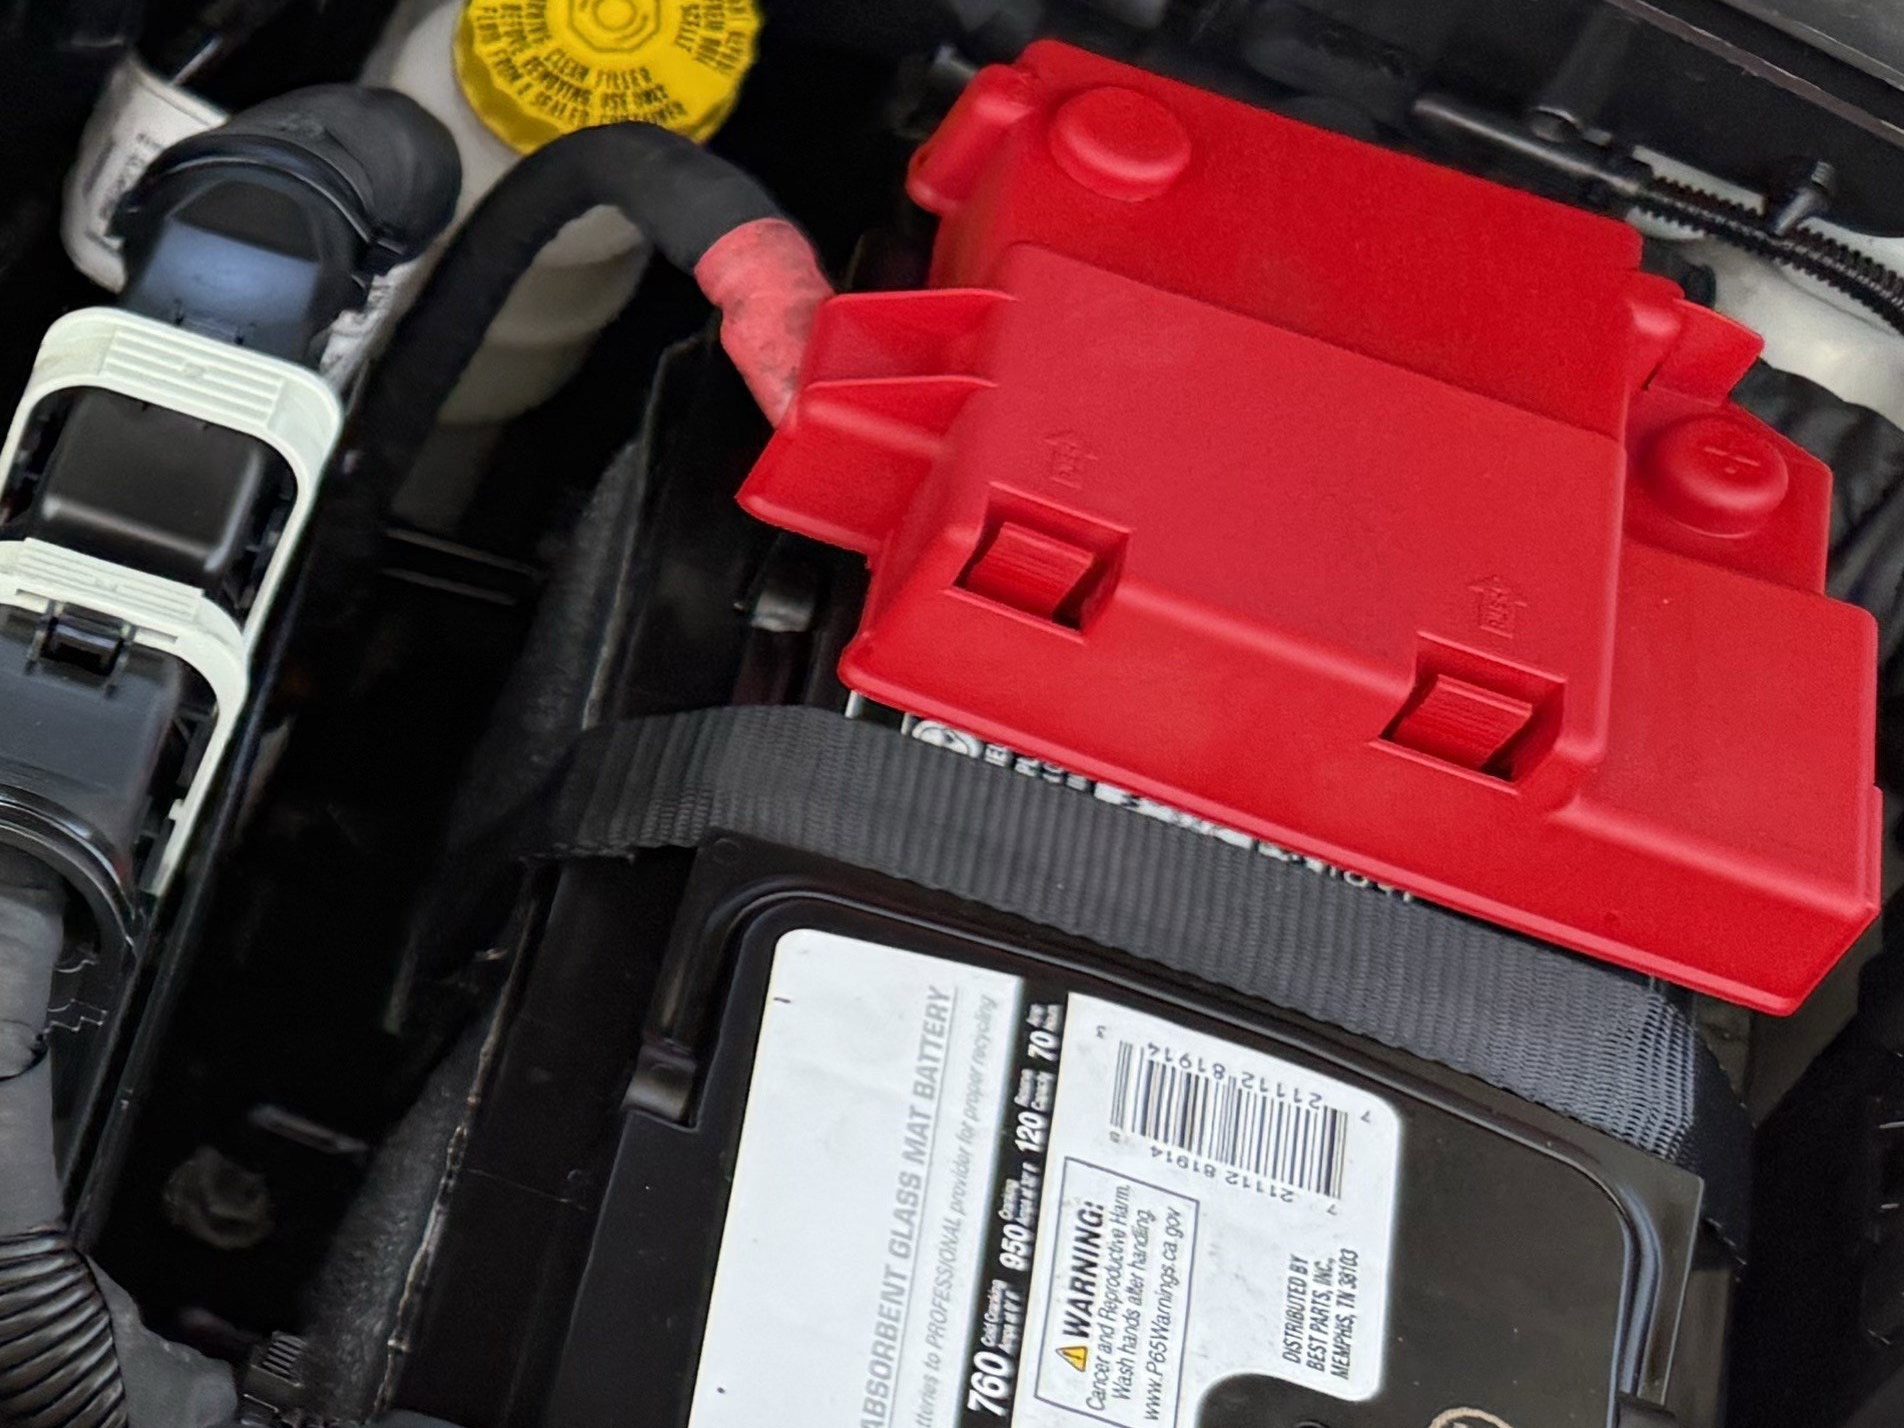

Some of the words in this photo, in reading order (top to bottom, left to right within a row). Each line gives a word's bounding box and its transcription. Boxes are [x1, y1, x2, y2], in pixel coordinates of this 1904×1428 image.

[912, 985, 950, 1101] BATTERY
[971, 994, 999, 1066] recycling
[1028, 1030, 1058, 1061] 70
[1143, 1042, 1226, 1079] 81914
[962, 1067, 985, 1122] proper
[1241, 1071, 1322, 1109] 21112
[902, 1104, 932, 1166] MAT
[955, 1122, 977, 1145] for
[1015, 1112, 1047, 1152] 120
[1360, 1111, 1370, 1123] 7
[949, 1146, 973, 1216] provider
[888, 1171, 922, 1260] GLASS
[999, 1223, 1032, 1271] 950
[1063, 1202, 1104, 1338] WARNING:
[1290, 1254, 1308, 1275] BY
[1338, 1248, 1358, 1289] 38103
[925, 1218, 962, 1350] PROFESSIONAL
[1097, 1228, 1132, 1322] Reproductive
[1122, 1272, 1145, 1306] after
[1282, 1276, 1307, 1364] DISTRIBUTED
[1309, 1285, 1333, 1335] PARTS,
[1336, 1290, 1355, 1308] TN
[1096, 1322, 1115, 1354] and
[1117, 1308, 1141, 1355] hands
[1306, 1335, 1327, 1372] BEST
[1330, 1314, 1357, 1380] MEMPHIS,
[923, 1352, 942, 1372] to
[967, 1352, 1011, 1416] 760
[1086, 1355, 1110, 1411] Cancer
[1111, 1358, 1135, 1400] Wash
